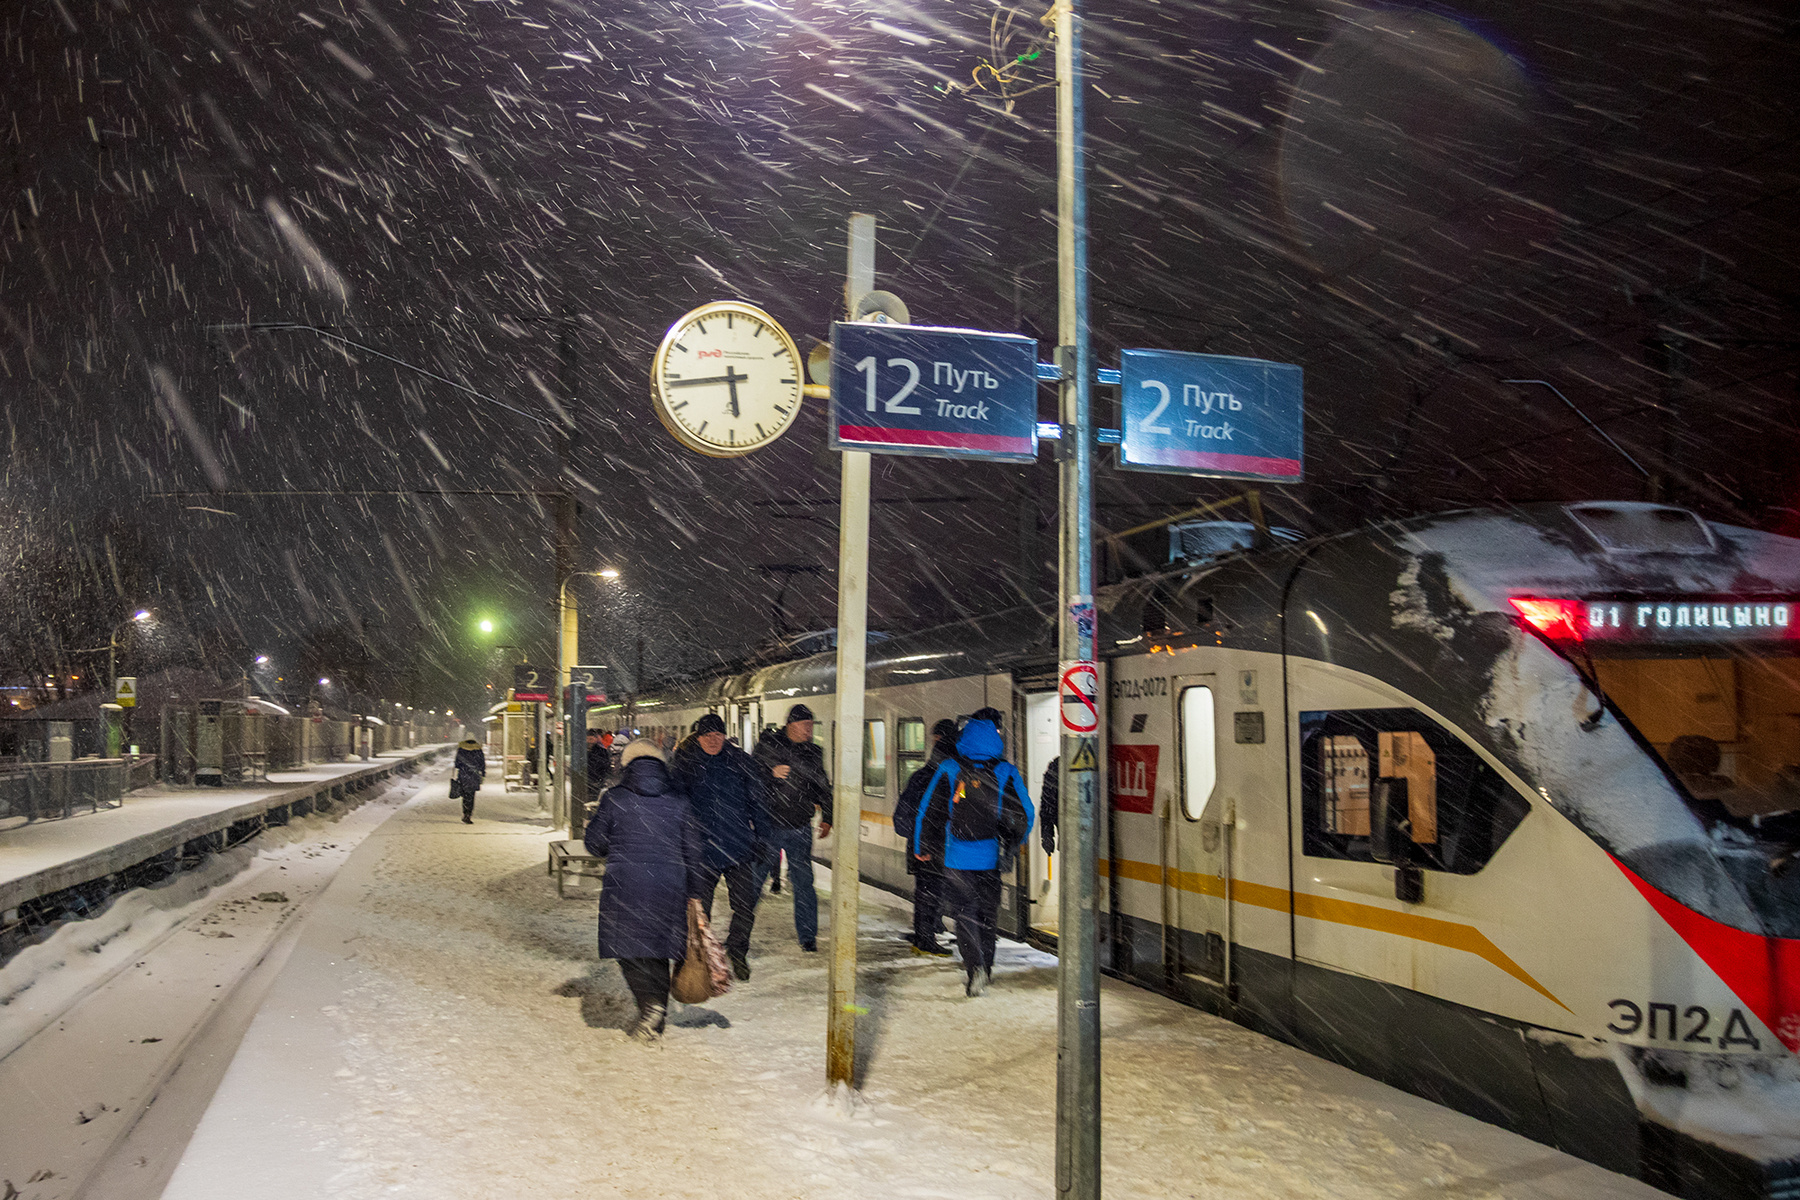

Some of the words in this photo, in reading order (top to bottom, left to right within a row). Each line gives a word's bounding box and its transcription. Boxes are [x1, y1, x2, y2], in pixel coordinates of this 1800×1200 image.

[854, 356, 922, 416] 12
[933, 361, 1000, 394] Путь
[935, 398, 990, 421] Track
[1140, 379, 1172, 436] 2
[1183, 383, 1243, 415] Путь
[1185, 419, 1235, 441] Track
[1637, 605, 1789, 629] ГОЛИЦЫНО
[526, 671, 541, 689] 2
[1606, 998, 1761, 1051] ЭП2Д
